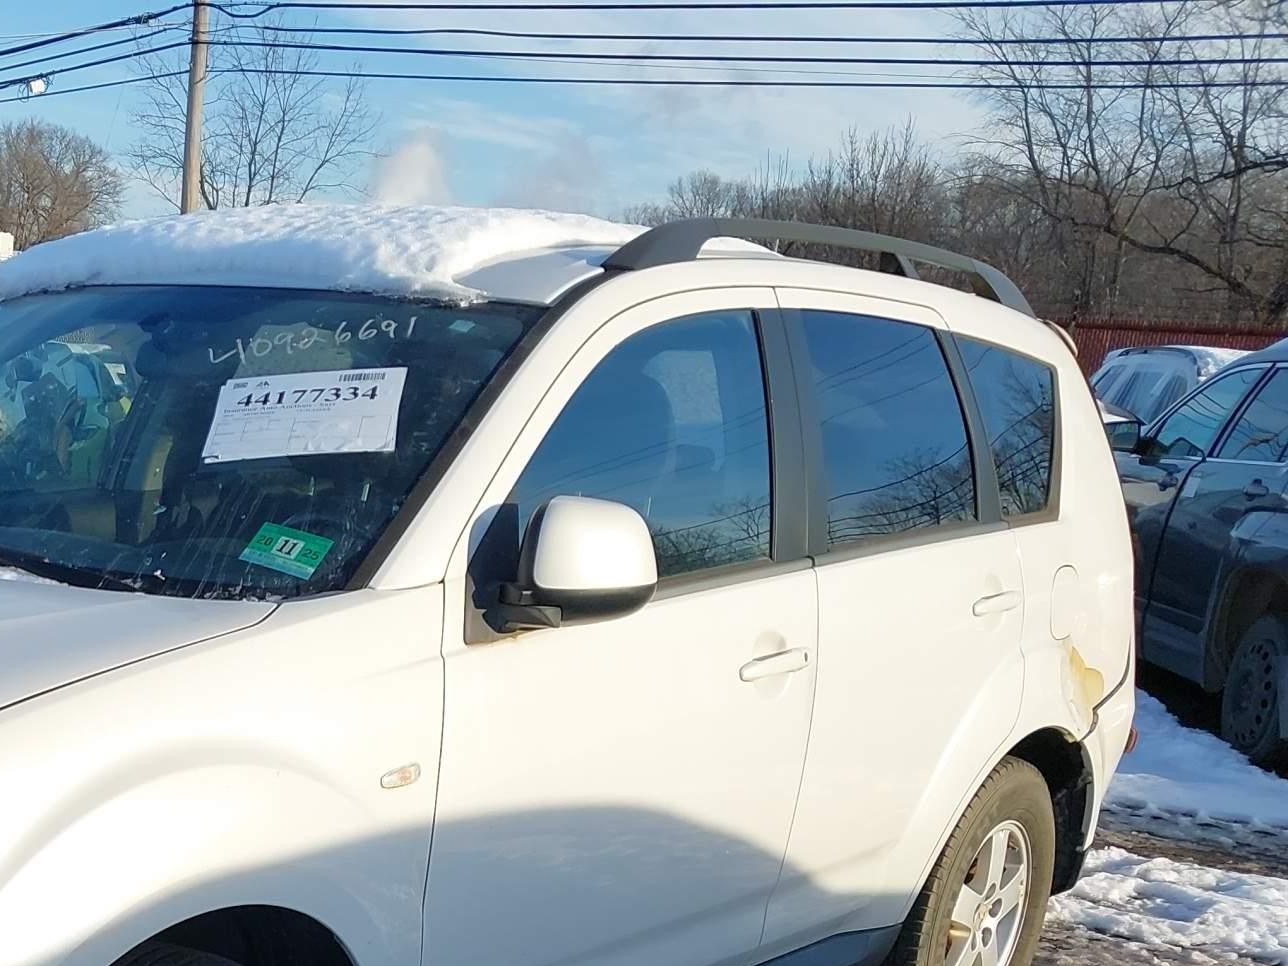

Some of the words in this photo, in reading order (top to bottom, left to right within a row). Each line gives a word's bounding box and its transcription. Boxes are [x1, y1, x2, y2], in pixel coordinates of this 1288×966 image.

[208, 316, 417, 365] 40926691
[237, 385, 378, 407] 44177334
[256, 535, 274, 546] 20
[276, 539, 300, 556] 11
[302, 548, 320, 560] 25
